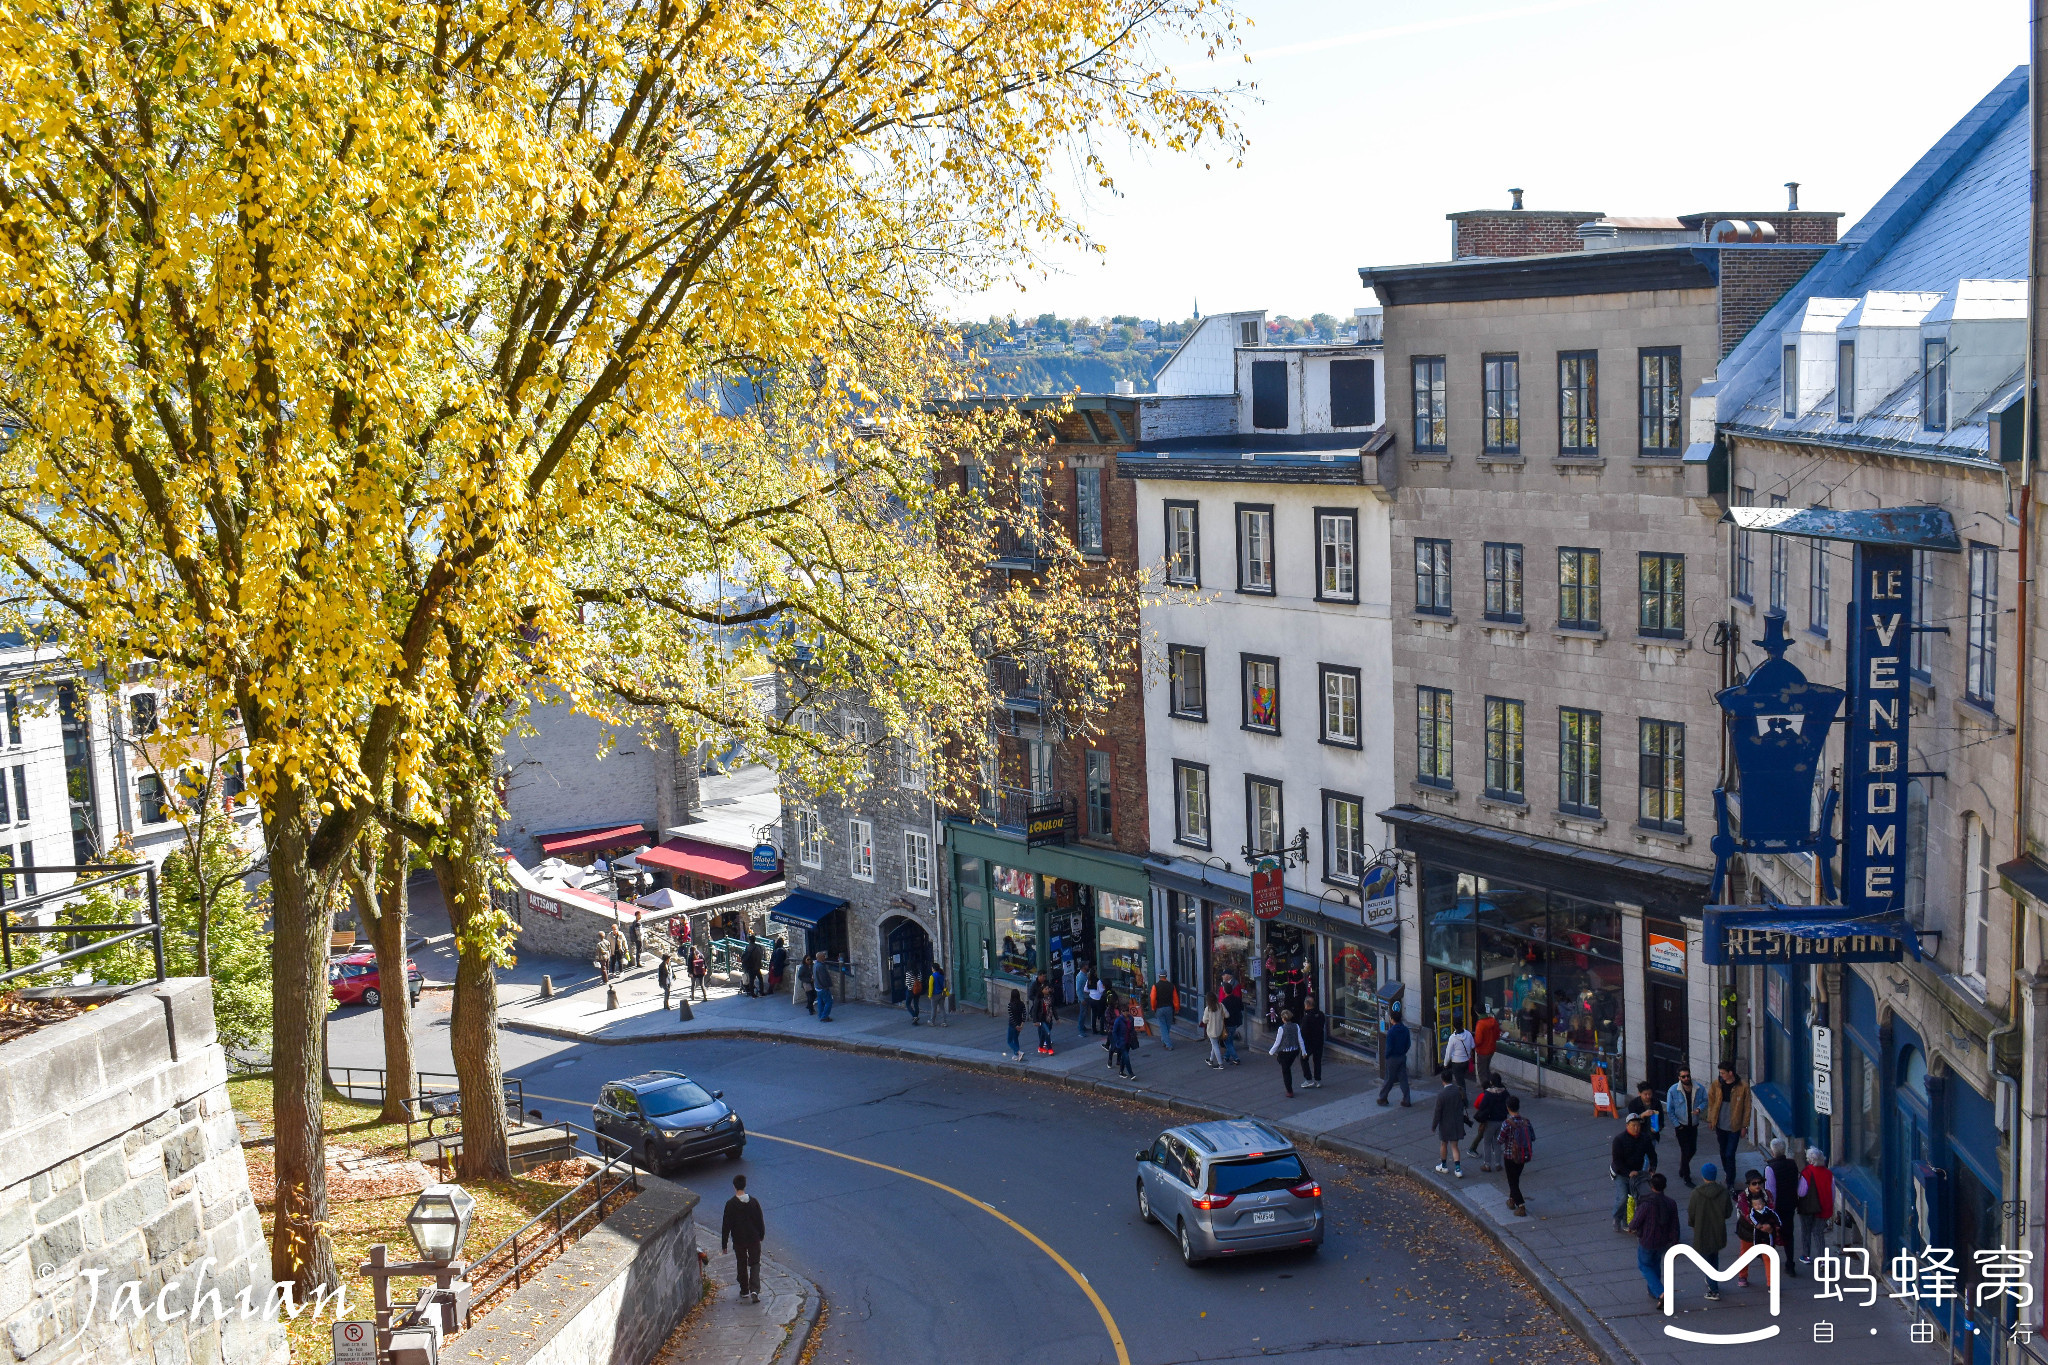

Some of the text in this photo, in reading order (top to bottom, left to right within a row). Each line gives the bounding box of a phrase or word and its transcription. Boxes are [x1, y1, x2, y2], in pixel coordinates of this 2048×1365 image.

[1871, 569, 1902, 600] LE
[1865, 613, 1902, 898] VENDOME
[529, 893, 558, 914] ARTISANS
